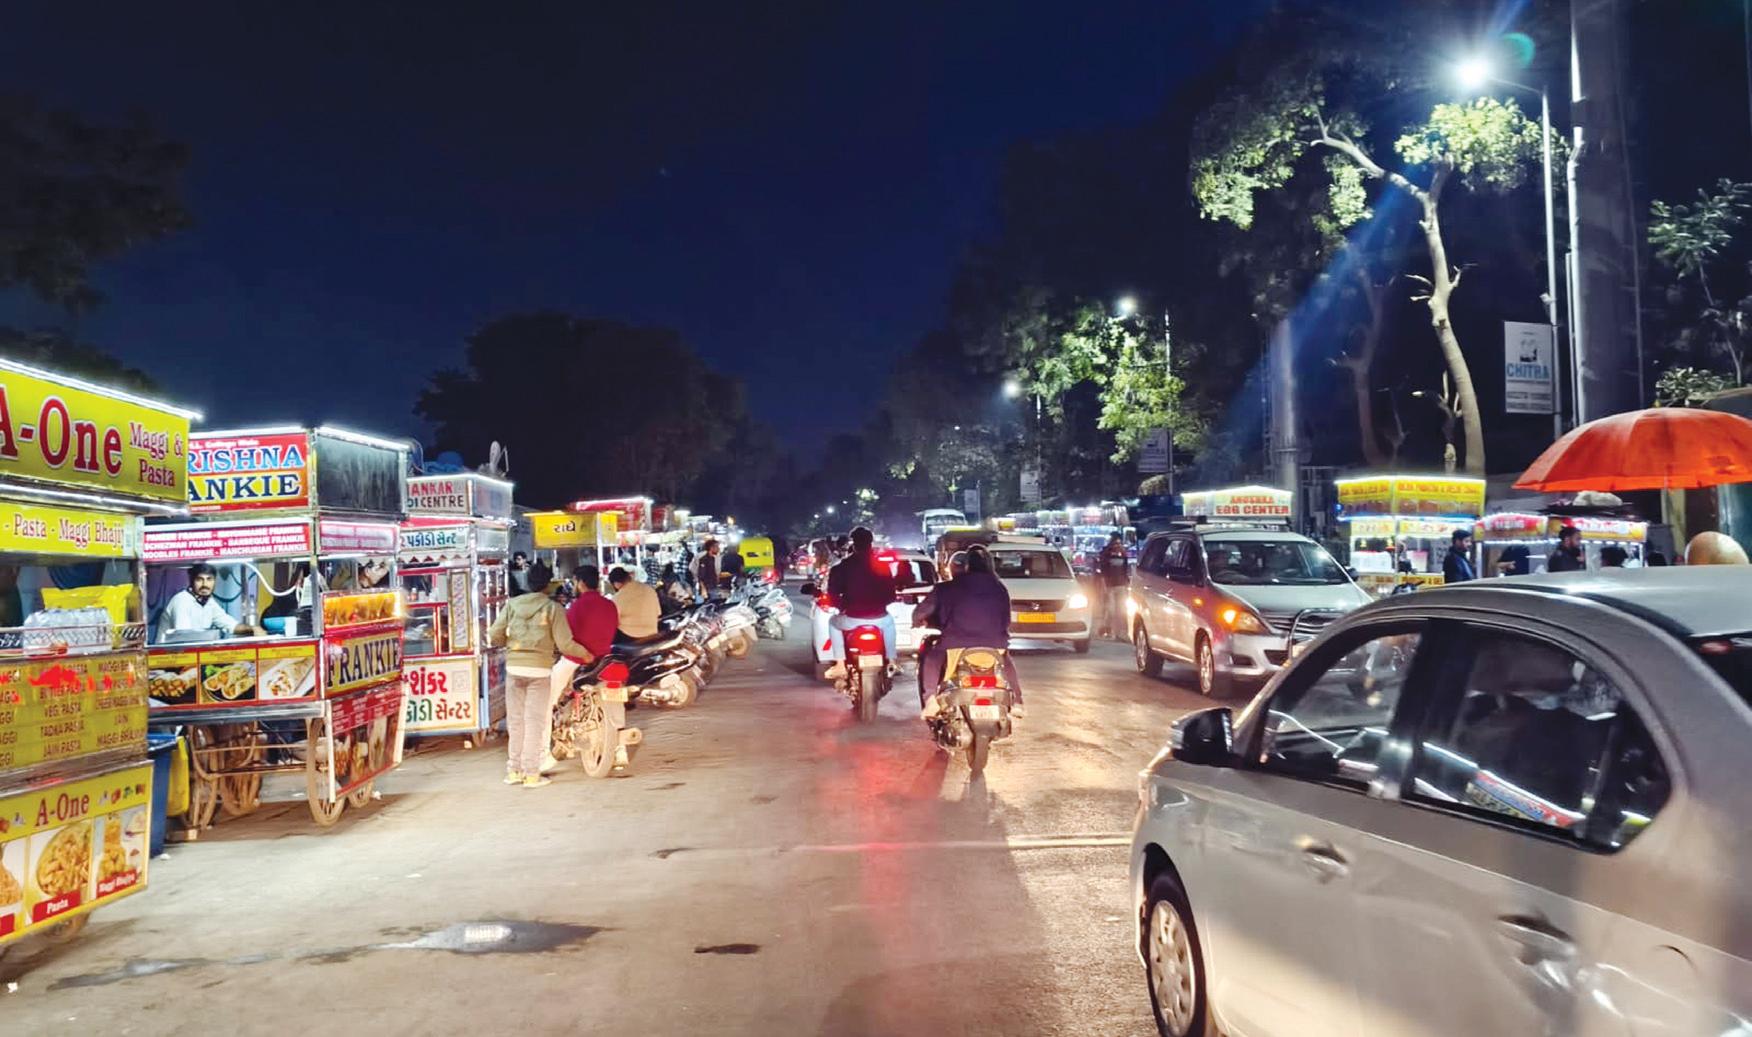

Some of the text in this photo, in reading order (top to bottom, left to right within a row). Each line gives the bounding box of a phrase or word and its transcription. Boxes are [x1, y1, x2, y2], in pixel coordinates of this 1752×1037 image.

[129, 422, 183, 460] Maggi &
[139, 459, 175, 486] Pasta
[188, 445, 305, 473] RISHNA
[188, 474, 301, 501] ANKIE
[406, 481, 453, 496] ANKAR
[421, 495, 464, 508] CENTRE
[1243, 505, 1289, 514] CENTER
[14, 513, 47, 538] Pasta
[59, 518, 91, 548] Maggi
[327, 637, 401, 687] FRANKIE
[35, 793, 90, 827] A-One
[46, 899, 69, 914] Pasta
